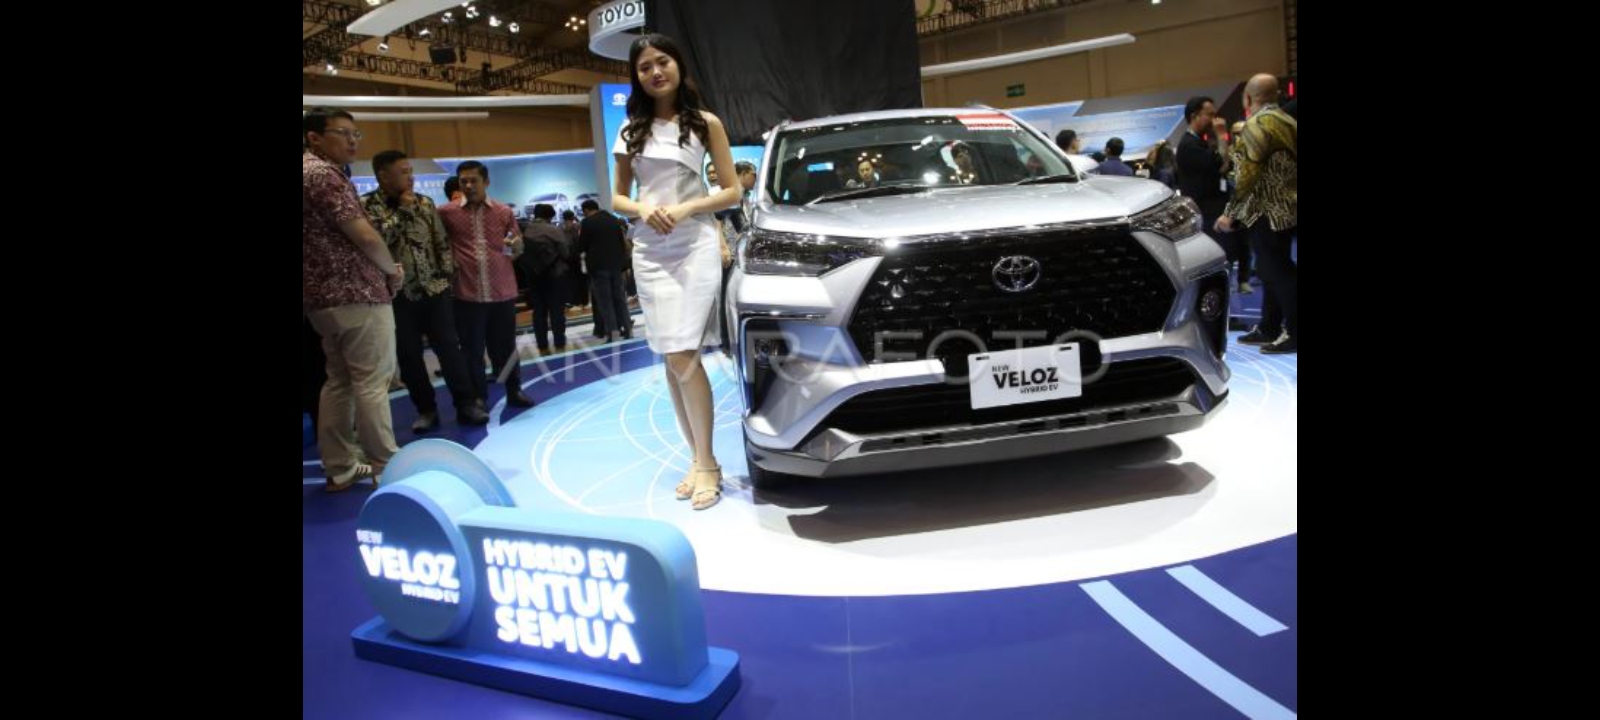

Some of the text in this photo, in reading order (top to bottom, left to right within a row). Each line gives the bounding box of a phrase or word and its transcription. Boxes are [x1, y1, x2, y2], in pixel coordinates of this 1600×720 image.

[991, 365, 1010, 373] NEW
[993, 367, 1059, 390] VELOZ
[1020, 386, 1048, 394] HYBRID
[356, 529, 383, 545] NEW
[359, 544, 461, 589] VELOZ
[482, 537, 627, 581] HYBRID EV
[486, 565, 636, 624] UNTUK
[494, 604, 642, 665] SEMUA
